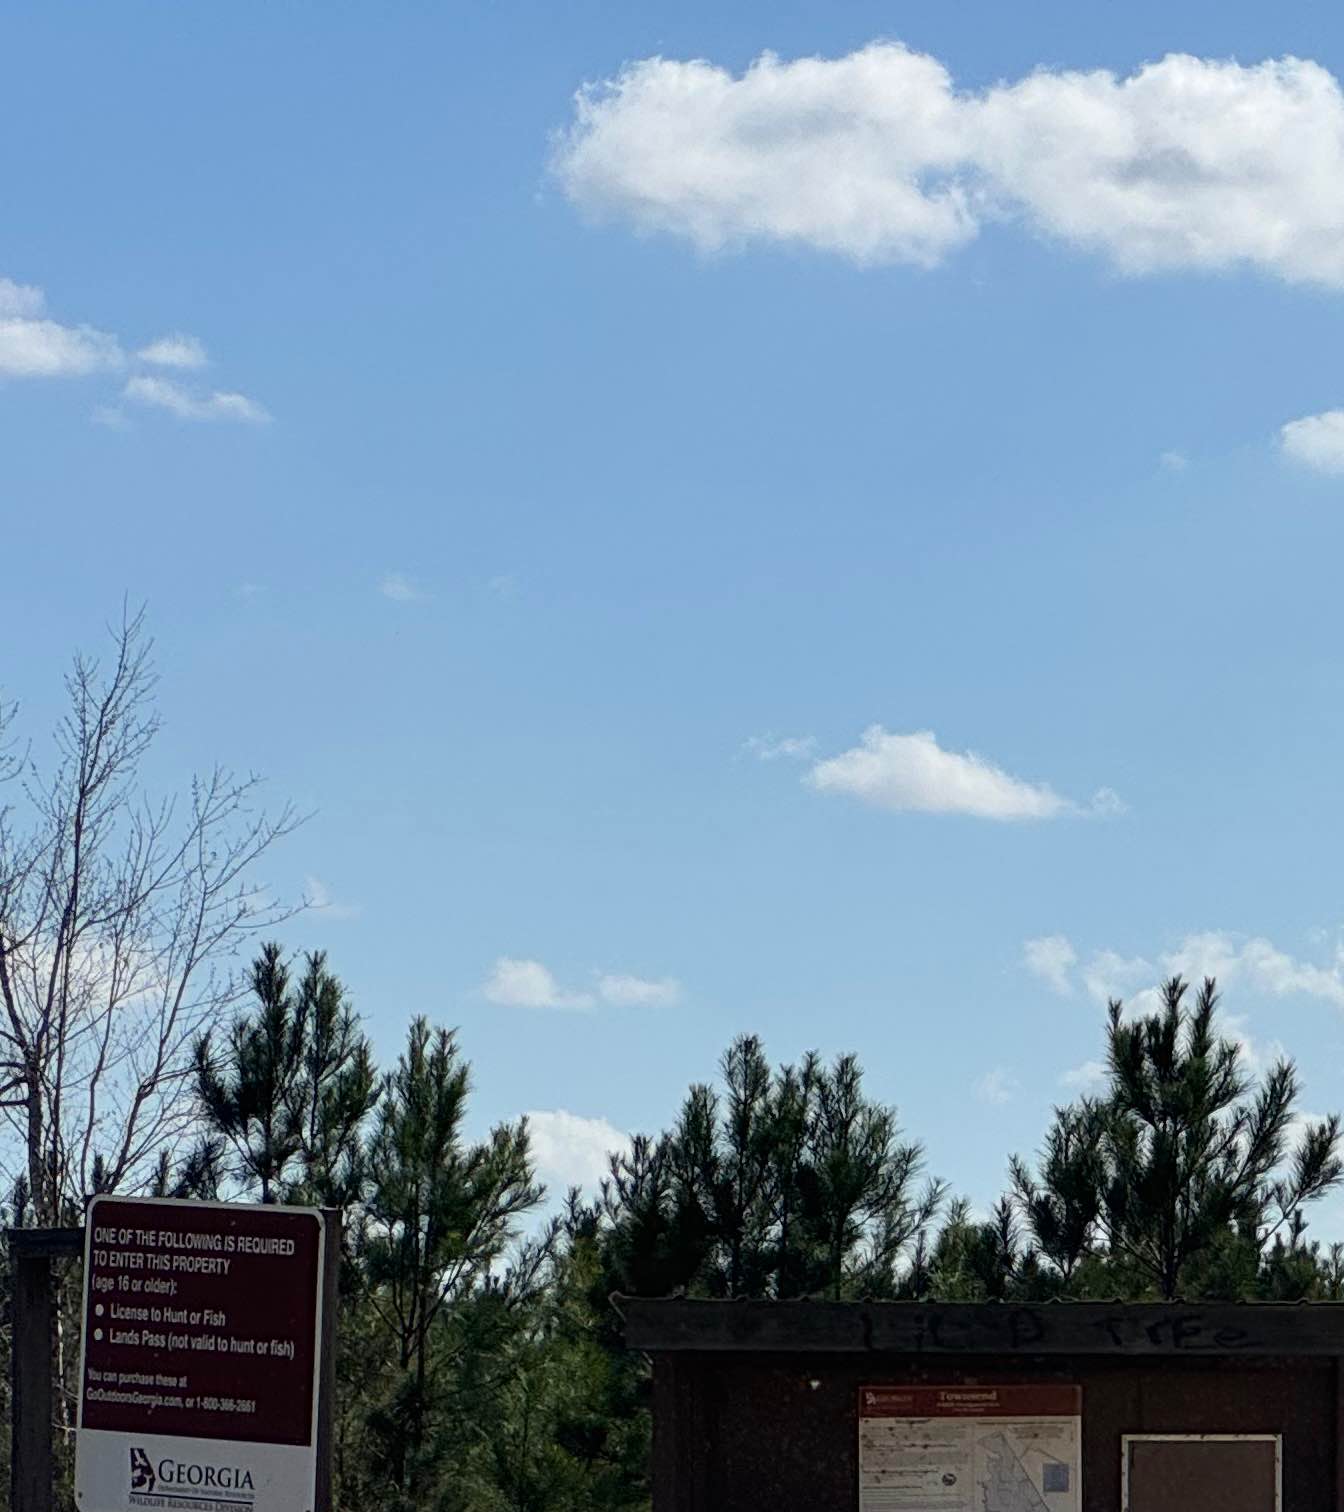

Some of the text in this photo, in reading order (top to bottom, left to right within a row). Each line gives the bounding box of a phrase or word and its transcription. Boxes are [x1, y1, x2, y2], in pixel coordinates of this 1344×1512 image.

[94, 1227, 295, 1256] ONE OF THE FOLLOWING IS REQUIRED
[93, 1249, 231, 1275] TO ENTER THIS PROPERTY
[91, 1274, 178, 1297] (age 16 or older):
[111, 1303, 226, 1327] License to Hunt or Fish
[109, 1329, 295, 1360] Lands Pass (not valid to hunt or fish)
[88, 1368, 188, 1388] You can purchase these at
[185, 1397, 195, 1408] or
